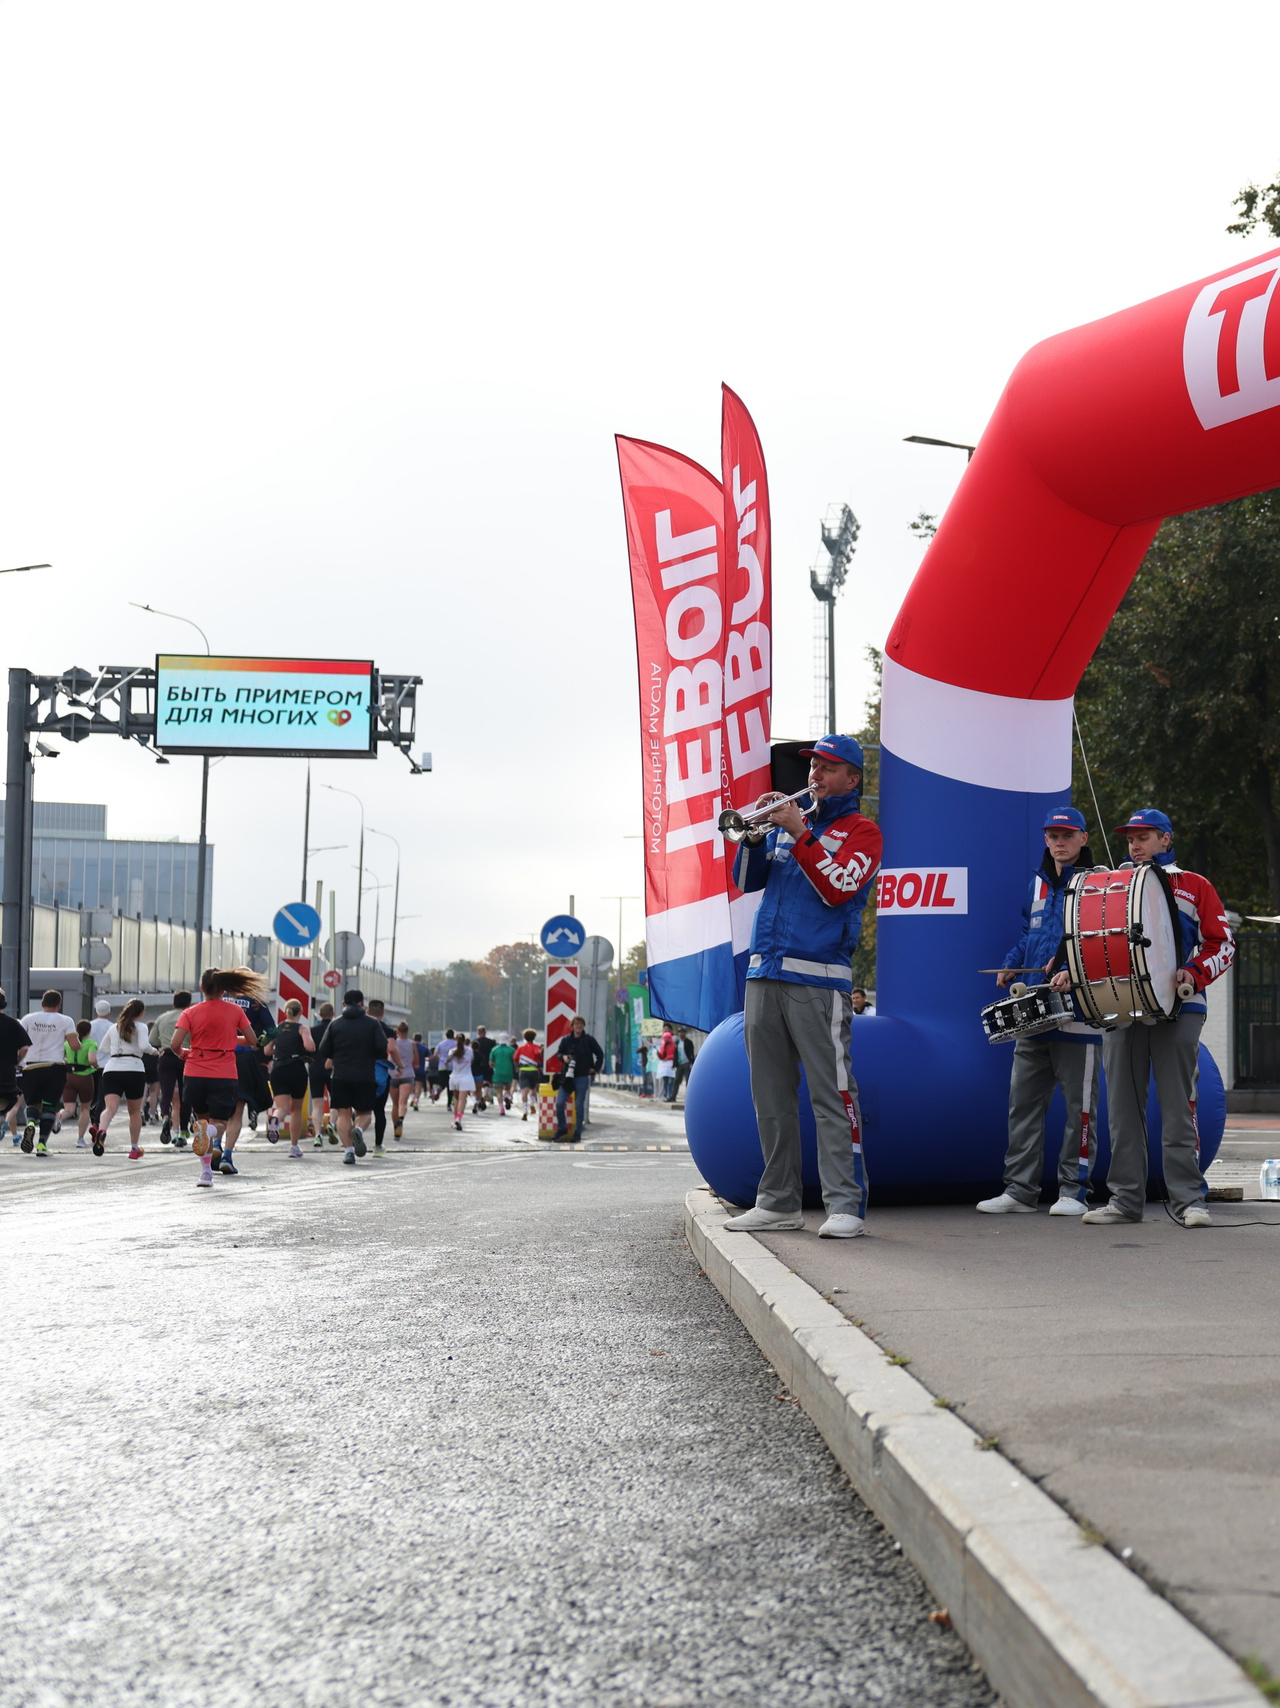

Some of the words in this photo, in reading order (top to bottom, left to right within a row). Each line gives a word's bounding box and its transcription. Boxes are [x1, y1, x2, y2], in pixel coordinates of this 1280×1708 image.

[167, 686, 227, 702] БЫТЬ
[235, 688, 362, 706] ПРИМЕРОМ
[165, 707, 213, 725] ДЛЯ
[221, 708, 318, 725] МНОГИХ
[876, 873, 956, 909] BOIL
[1173, 888, 1196, 902] TEBOIL
[846, 1103, 858, 1130] TEBOIL
